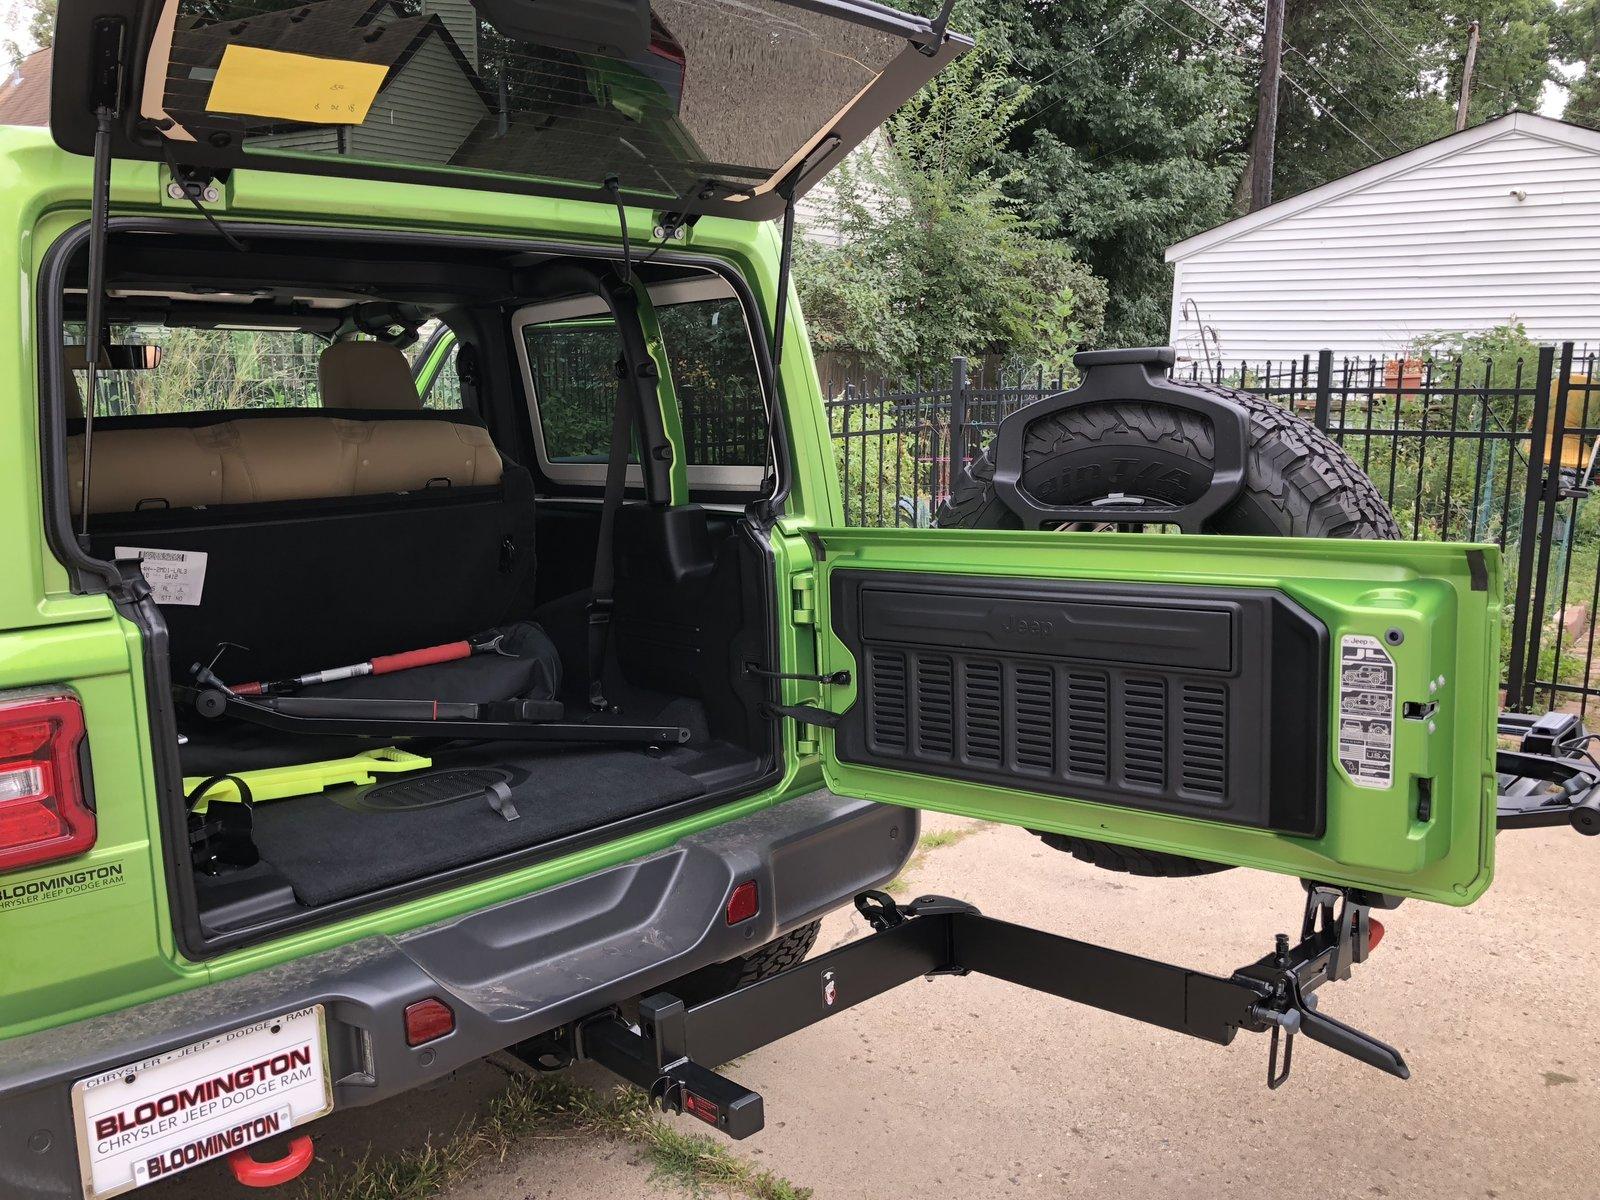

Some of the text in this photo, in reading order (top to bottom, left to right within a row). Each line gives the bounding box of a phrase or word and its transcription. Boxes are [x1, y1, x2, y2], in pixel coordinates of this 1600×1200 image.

[1001, 614, 1056, 640] Jeep
[1351, 637, 1368, 645] Jeep
[0, 863, 123, 900] LOOMINGTON
[0, 875, 124, 909] HRYSLER JEEP DODGE RAM
[87, 1007, 314, 1088] CHRYSLER JEEP DODGE RAM
[95, 1045, 312, 1141] BLOOMINGTON
[97, 1066, 312, 1154] CHRYSLER JEEP DODGE RAM
[147, 1112, 280, 1179] BLOOMINGTON
